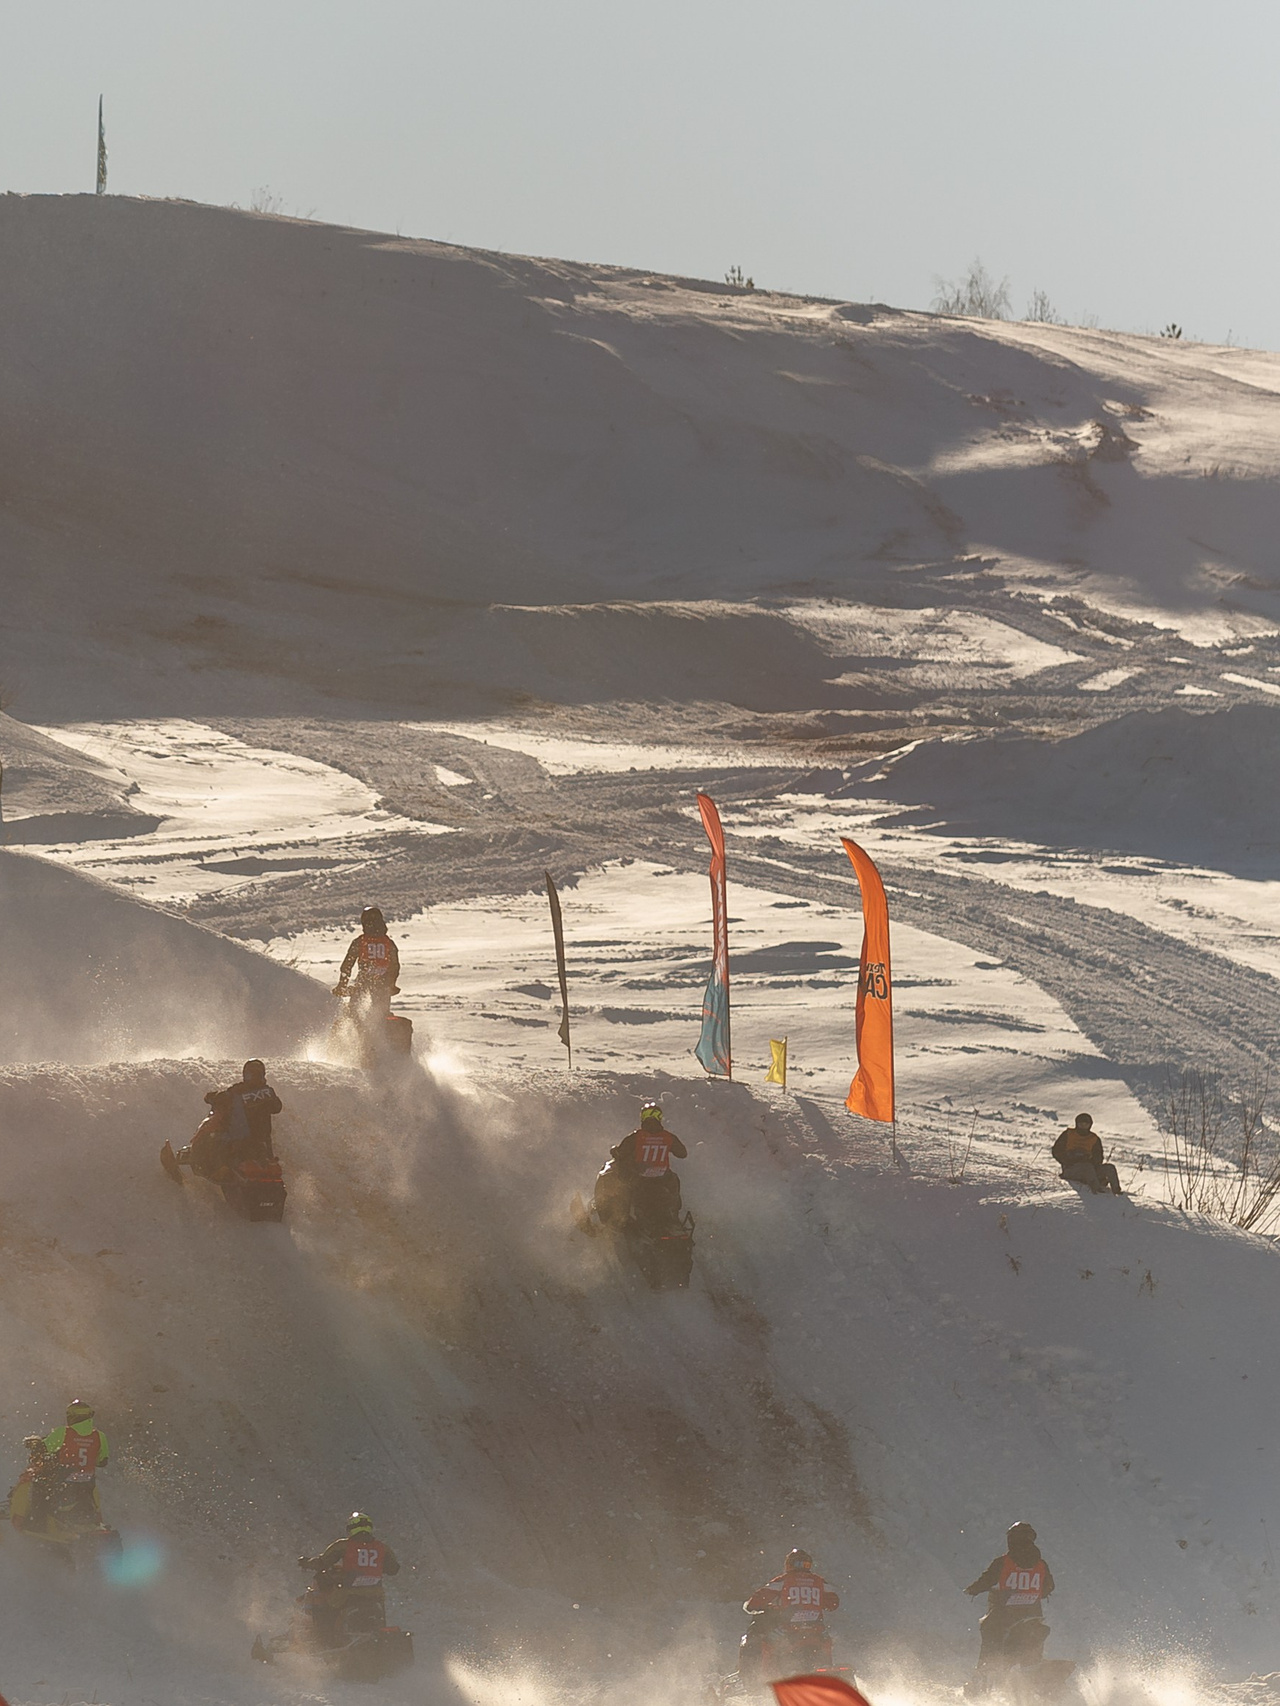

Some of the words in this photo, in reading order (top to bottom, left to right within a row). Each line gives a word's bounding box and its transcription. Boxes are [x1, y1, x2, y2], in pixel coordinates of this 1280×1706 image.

[367, 943, 386, 959] 90
[241, 1088, 272, 1104] FXR
[642, 1145, 668, 1162] 777
[78, 1447, 88, 1467] 5
[357, 1548, 378, 1568] 82
[1005, 1572, 1040, 1591] 404
[789, 1586, 820, 1606] 999
